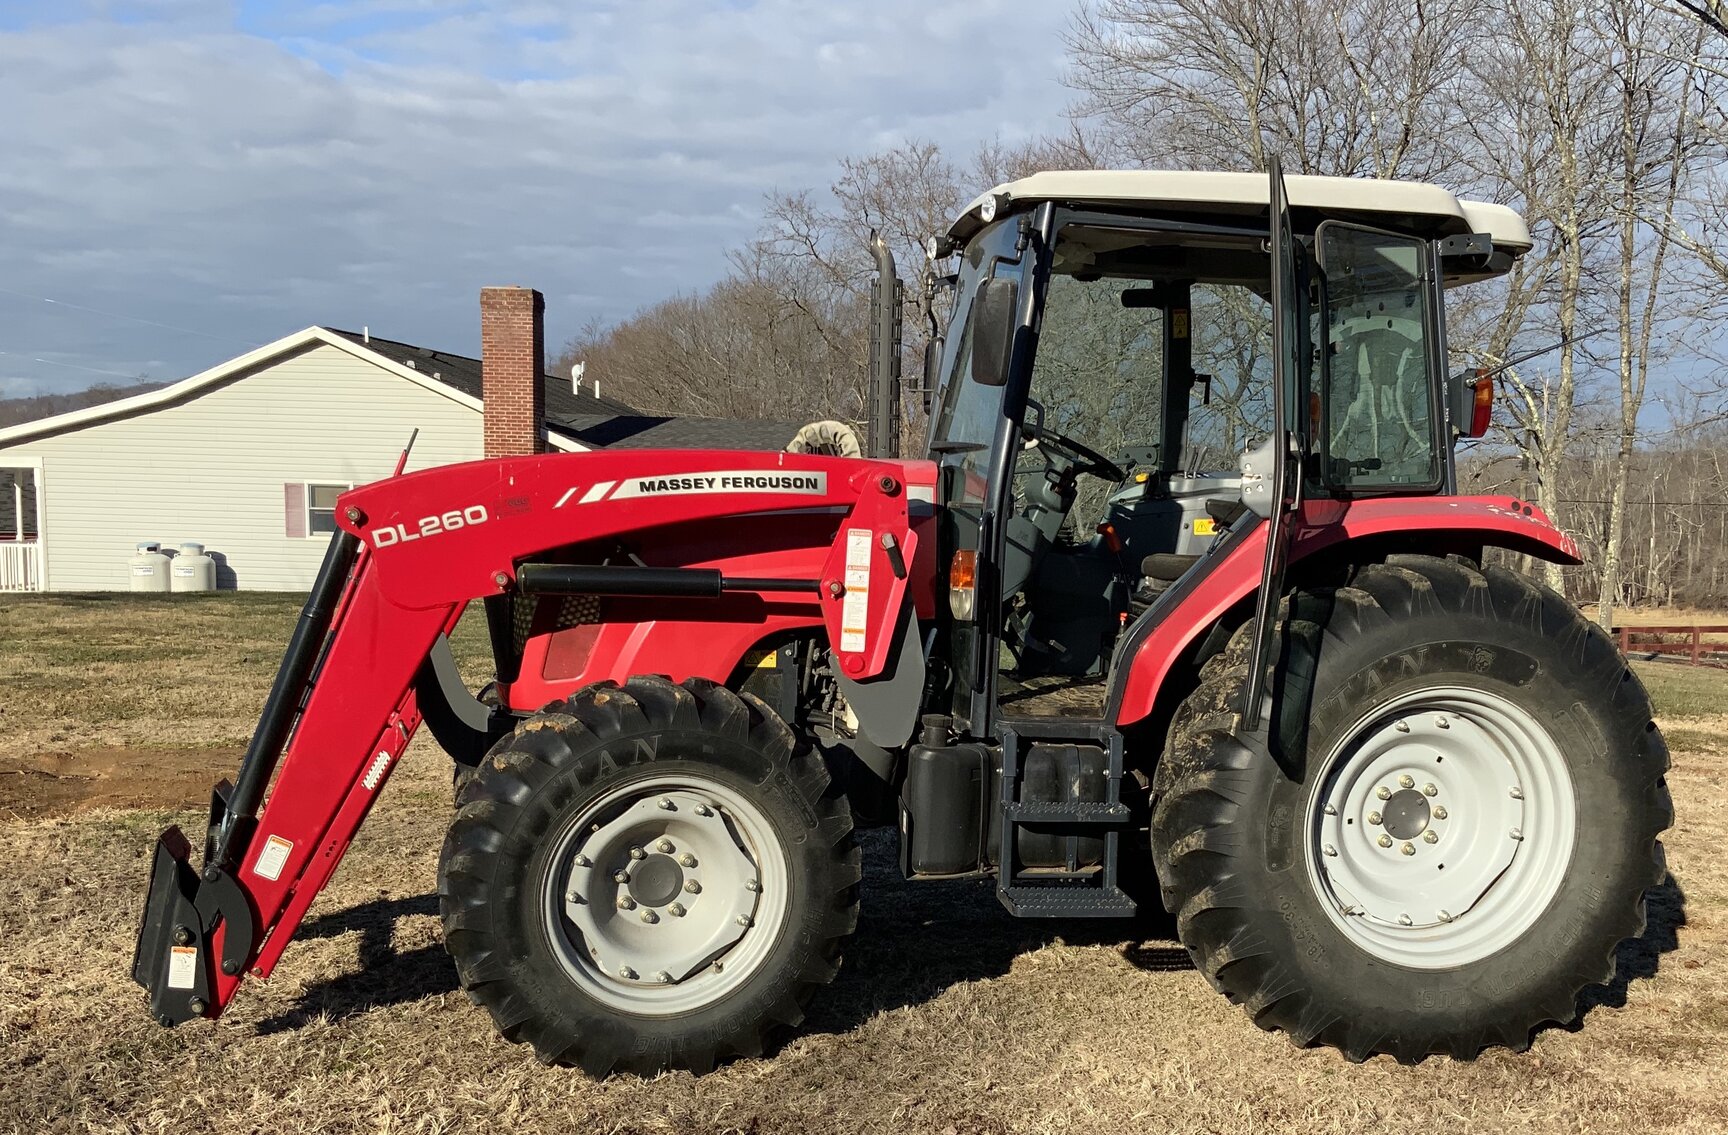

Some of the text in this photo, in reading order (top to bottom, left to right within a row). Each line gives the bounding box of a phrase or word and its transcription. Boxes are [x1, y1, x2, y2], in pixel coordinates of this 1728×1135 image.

[639, 476, 818, 492] MASSEY FERGUSON
[371, 504, 488, 549] DL260
[1309, 647, 1429, 739] ITAN
